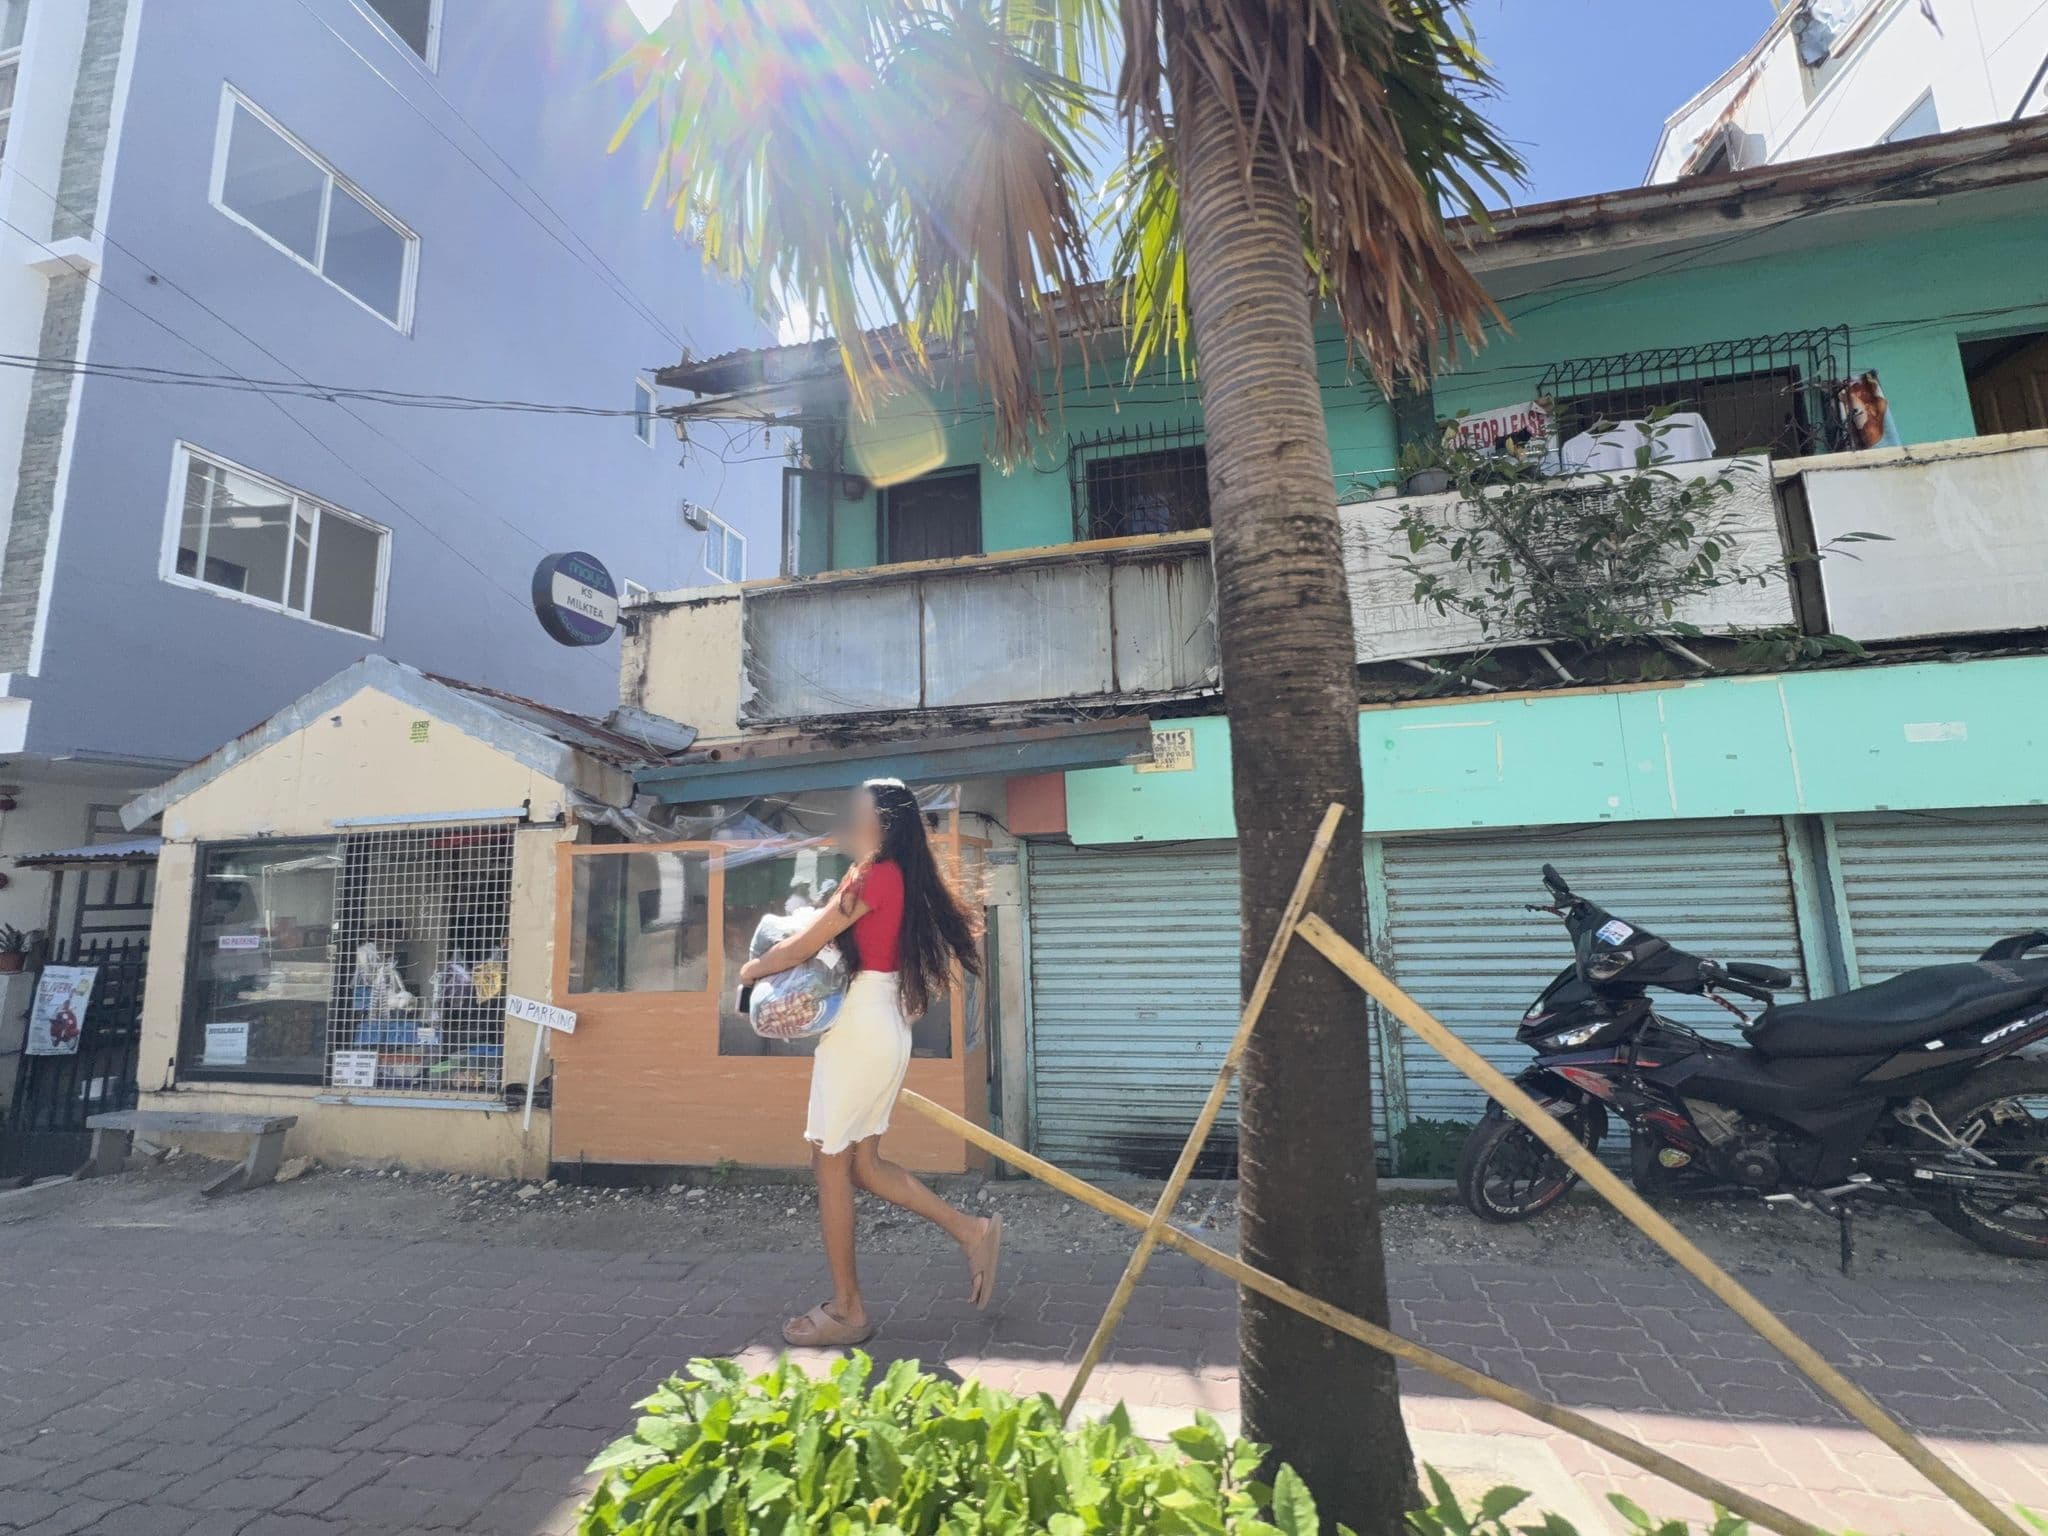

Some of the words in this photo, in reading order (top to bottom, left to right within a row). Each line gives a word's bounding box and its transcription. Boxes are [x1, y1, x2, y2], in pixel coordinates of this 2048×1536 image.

[1472, 418, 1499, 448] FOR
[1502, 410, 1547, 438] LEASE
[566, 595, 604, 620] MILKTEA
[1153, 731, 1186, 746] SUS
[508, 998, 523, 1014] NO
[525, 1002, 575, 1028] PARKING
